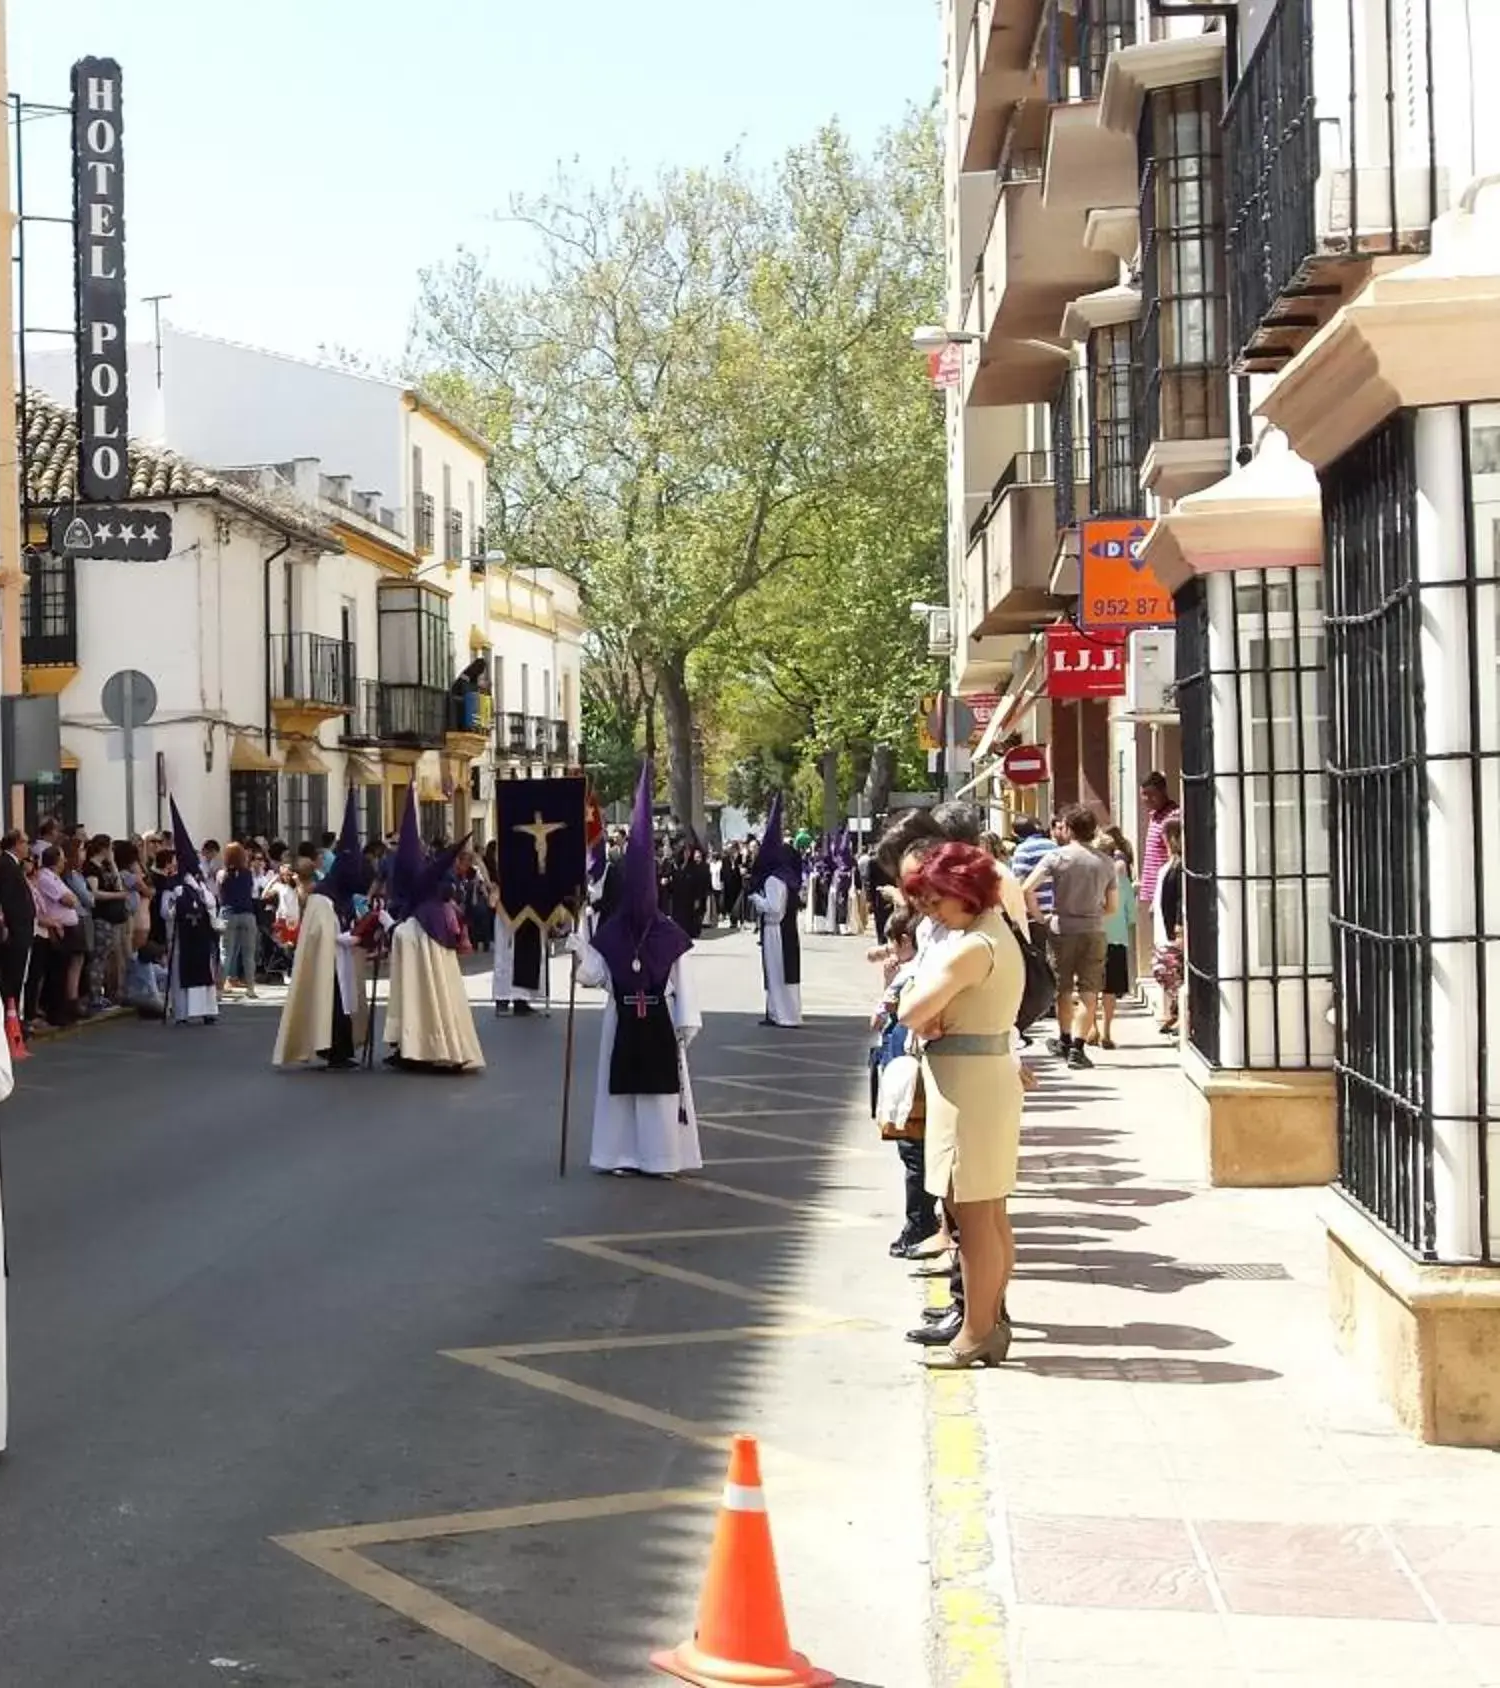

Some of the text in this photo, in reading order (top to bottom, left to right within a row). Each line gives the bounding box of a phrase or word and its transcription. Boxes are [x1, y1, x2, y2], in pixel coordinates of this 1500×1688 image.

[87, 77, 120, 480] HOTEL POLO
[1093, 597, 1129, 616] 952
[1137, 597, 1159, 615] 87
